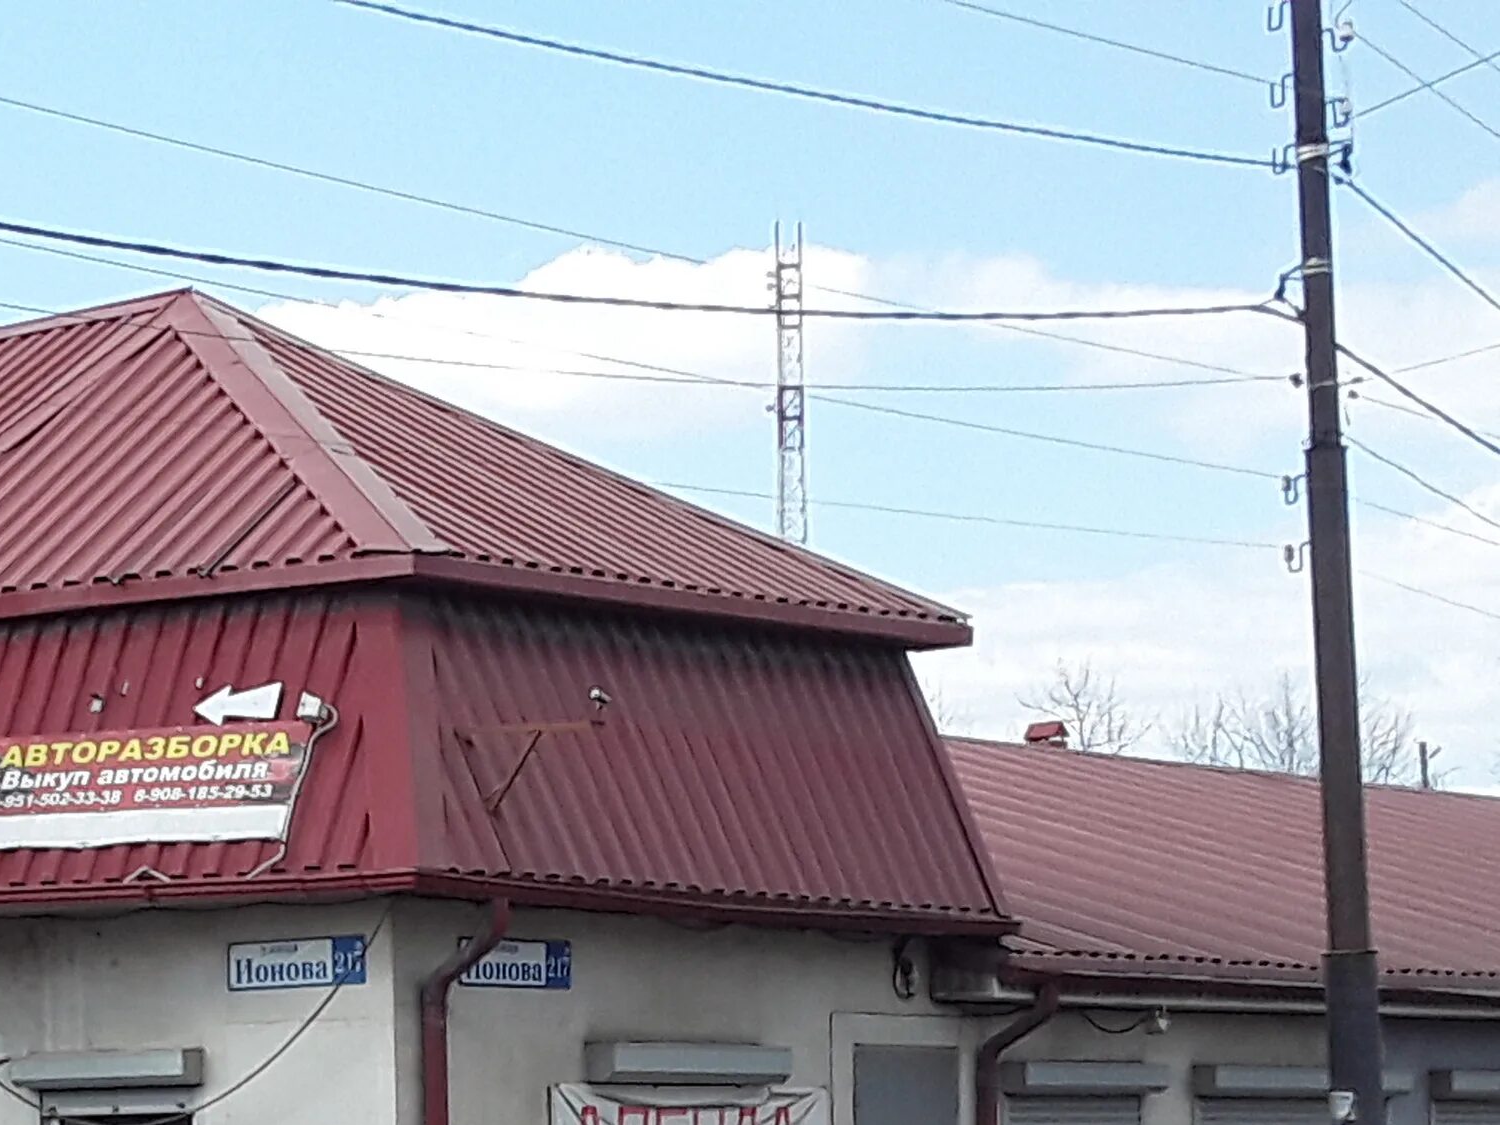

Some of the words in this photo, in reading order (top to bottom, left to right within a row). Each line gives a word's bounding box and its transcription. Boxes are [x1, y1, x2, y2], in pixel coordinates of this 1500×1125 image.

[0, 732, 291, 768] АВТОРАЗБОРКА
[0, 770, 89, 791] Выкуп
[97, 760, 269, 786] автомобиля
[236, 957, 329, 984] Ионова
